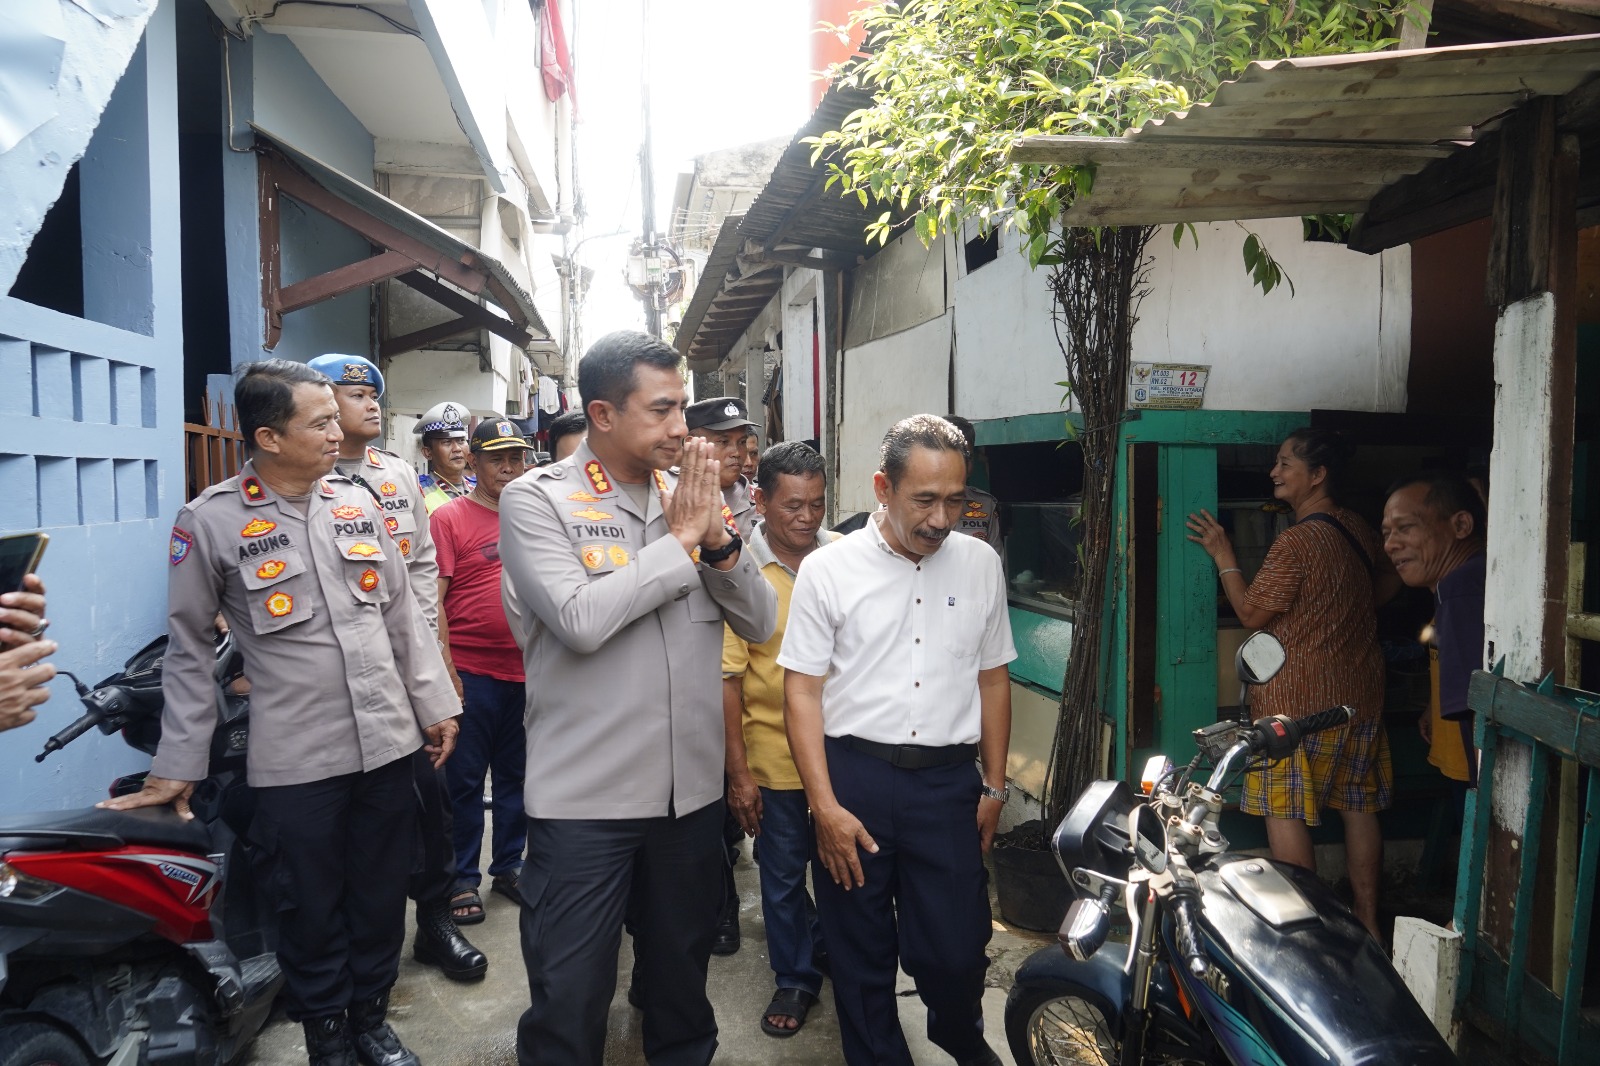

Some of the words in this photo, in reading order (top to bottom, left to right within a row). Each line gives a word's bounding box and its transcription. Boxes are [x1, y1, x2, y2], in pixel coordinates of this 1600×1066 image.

[1180, 371, 1198, 386] 12
[334, 520, 375, 535] POLRI
[572, 524, 626, 539] TWEDI
[238, 533, 290, 561] AGUNG
